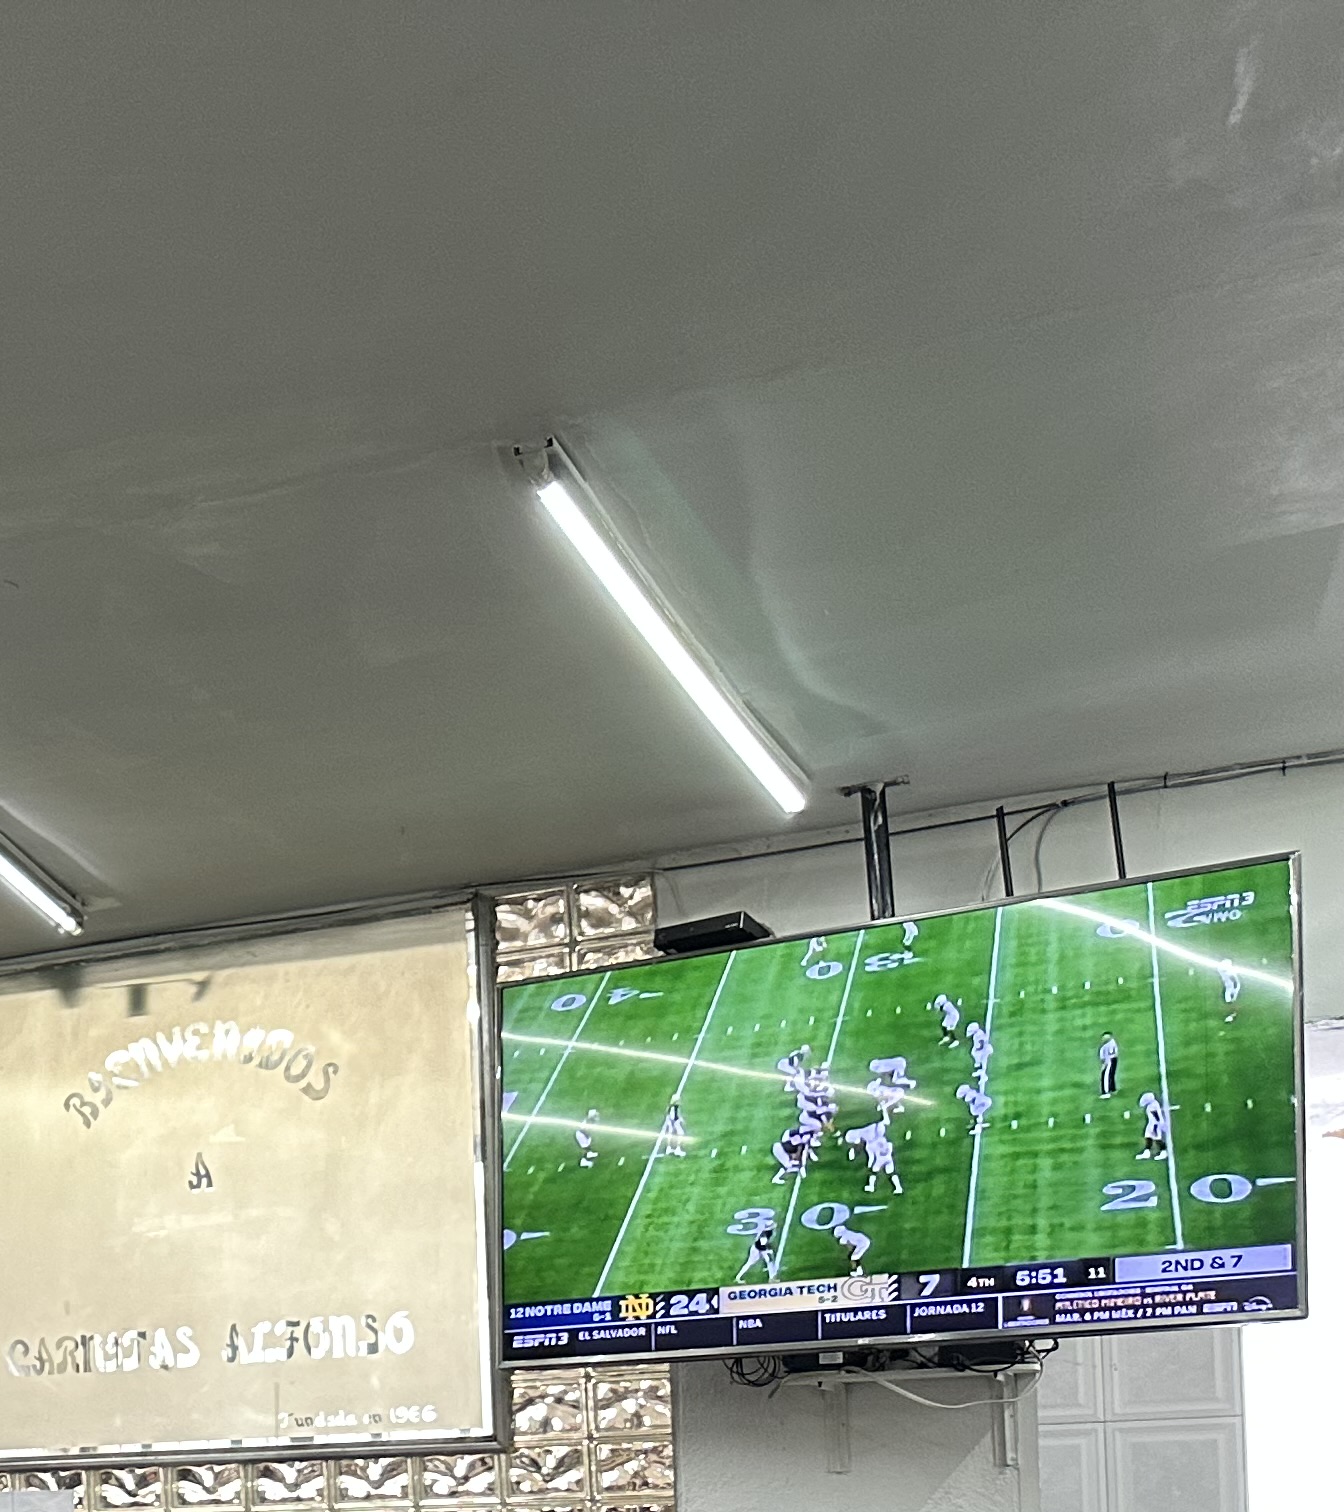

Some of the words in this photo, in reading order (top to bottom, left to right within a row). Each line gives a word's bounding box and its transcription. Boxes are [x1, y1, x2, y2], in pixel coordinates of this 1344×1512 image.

[188, 1151, 215, 1194] A
[1161, 1256, 1205, 1274] 2ND
[1209, 1255, 1226, 1269] &
[1230, 1253, 1244, 1268] 7
[918, 1273, 941, 1297] 7
[966, 1277, 995, 1288] 4TH
[1015, 1266, 1067, 1286] 5:51
[1087, 1267, 1106, 1279] 11
[727, 1286, 798, 1301] GEORGIA
[798, 1282, 838, 1296] TECH
[509, 1307, 523, 1319] 12
[524, 1303, 571, 1318] NOTRE
[572, 1299, 612, 1315] DAME
[669, 1293, 710, 1316] 24
[913, 1303, 970, 1317] JORNADA
[970, 1302, 985, 1313] 12
[738, 1318, 763, 1329] NBA
[824, 1309, 887, 1323] TITULARES
[221, 1310, 415, 1366] ALFONSO
[592, 1327, 646, 1340] SALVADOR
[656, 1324, 678, 1336] NFL
